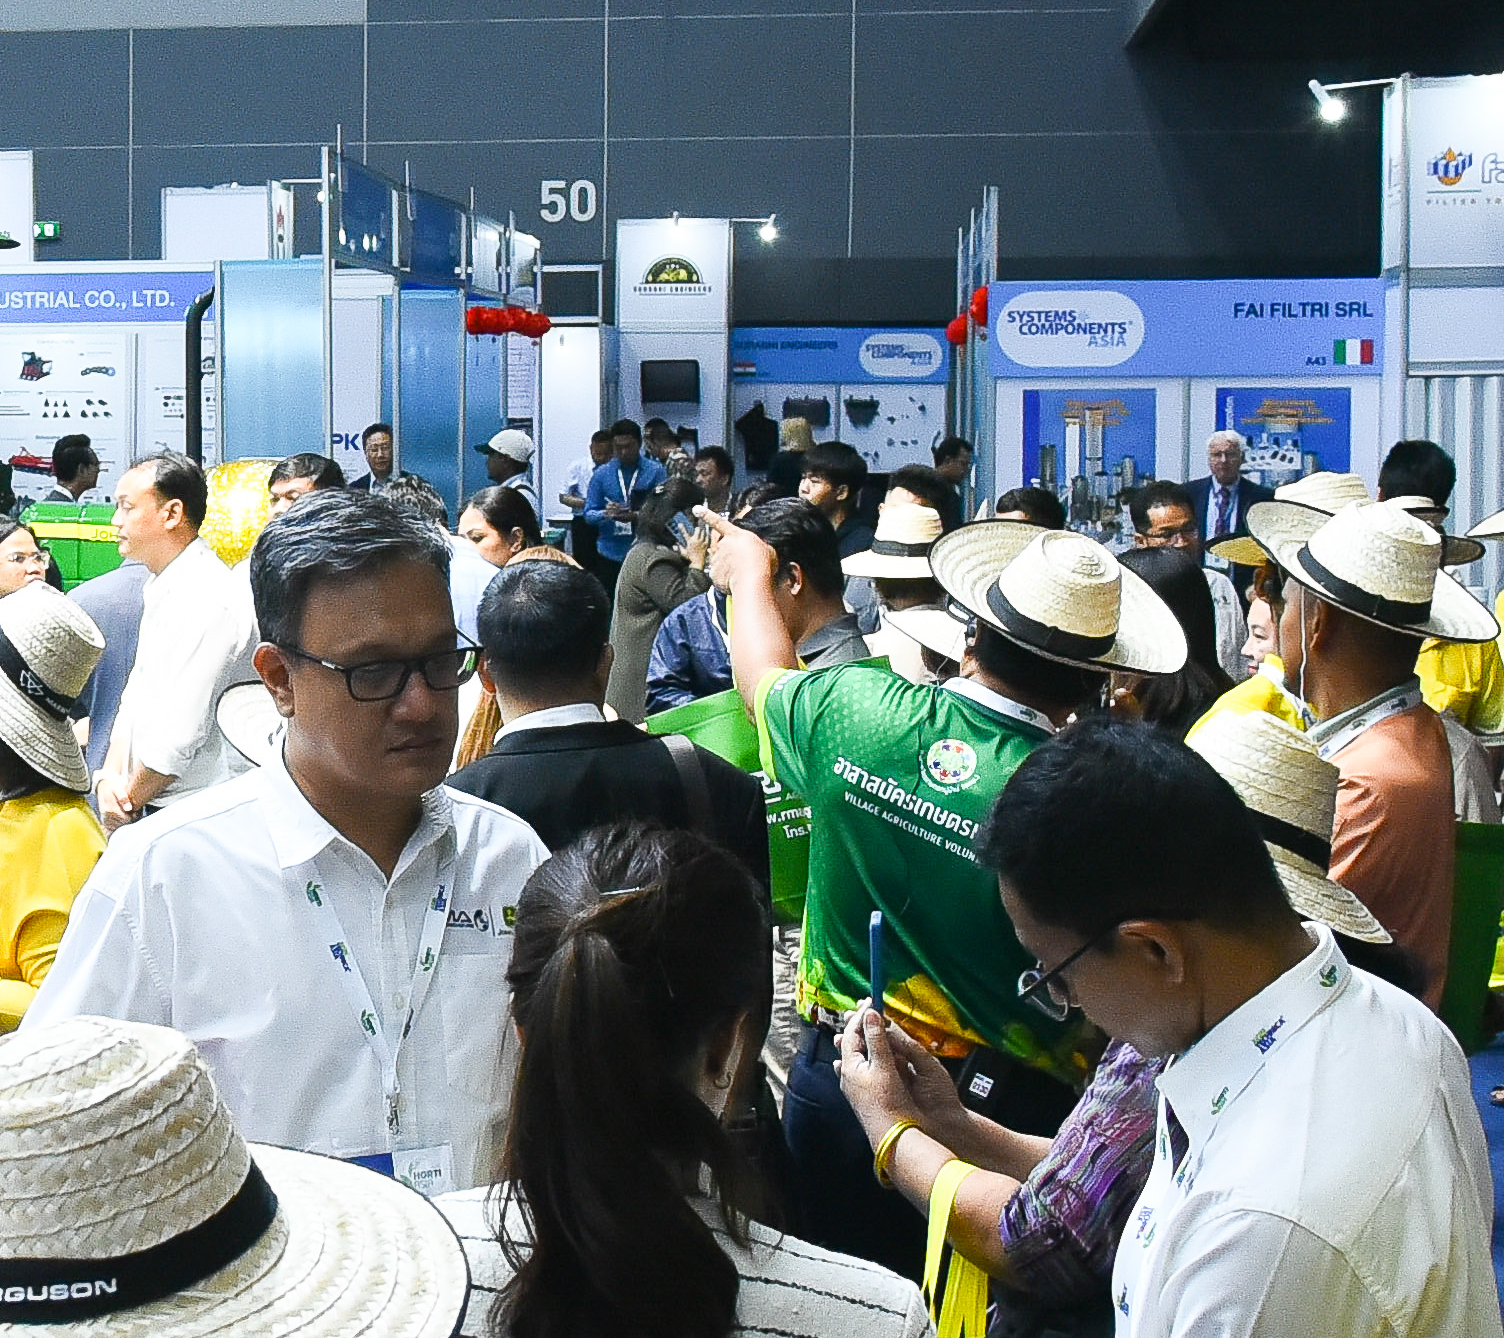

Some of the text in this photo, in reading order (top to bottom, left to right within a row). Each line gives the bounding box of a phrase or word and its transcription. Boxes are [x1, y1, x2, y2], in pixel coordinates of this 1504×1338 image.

[538, 180, 598, 223] 50
[84, 291, 126, 311] CO.,
[132, 291, 175, 308] LTD.
[1007, 310, 1077, 323] SYSTEMS
[1233, 302, 1374, 318] FAI FILTRI SRL
[1019, 322, 1127, 336] COMPONENTS
[1087, 335, 1127, 348] ASIA
[845, 790, 881, 817] VILLAGE
[881, 810, 944, 849] AGRICULTURE
[413, 1168, 442, 1180] HORTI
